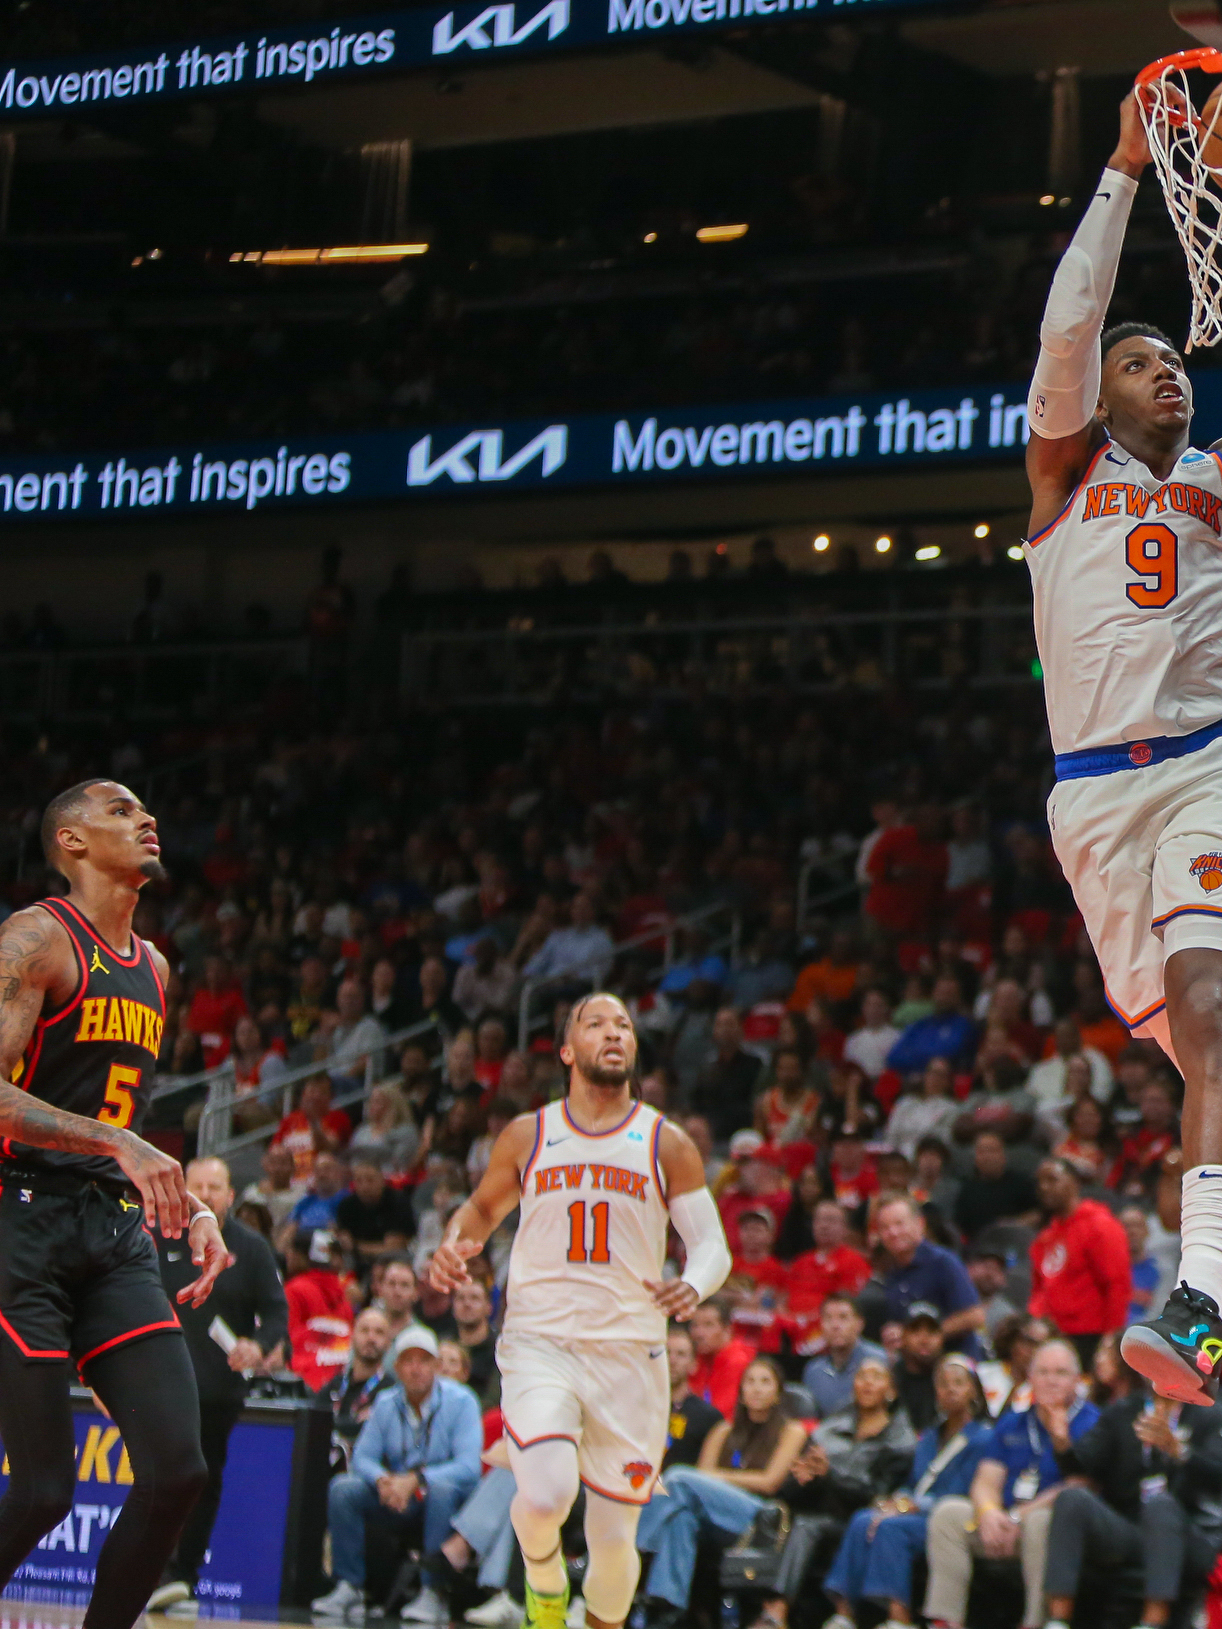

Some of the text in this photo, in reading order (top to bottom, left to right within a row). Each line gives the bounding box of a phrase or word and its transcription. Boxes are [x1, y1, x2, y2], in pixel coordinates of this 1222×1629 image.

[175, 42, 249, 89] that
[255, 28, 396, 82] inspires
[612, 405, 867, 473] Movement
[874, 399, 979, 454] that
[98, 458, 182, 509] that
[190, 446, 351, 510] inspires
[1081, 482, 1222, 537] NEW YORK
[1126, 523, 1178, 609] 9
[75, 996, 165, 1060] HAWKS
[97, 1063, 142, 1128] 5
[535, 1164, 649, 1202] NEW YORK
[567, 1201, 610, 1263] 11
